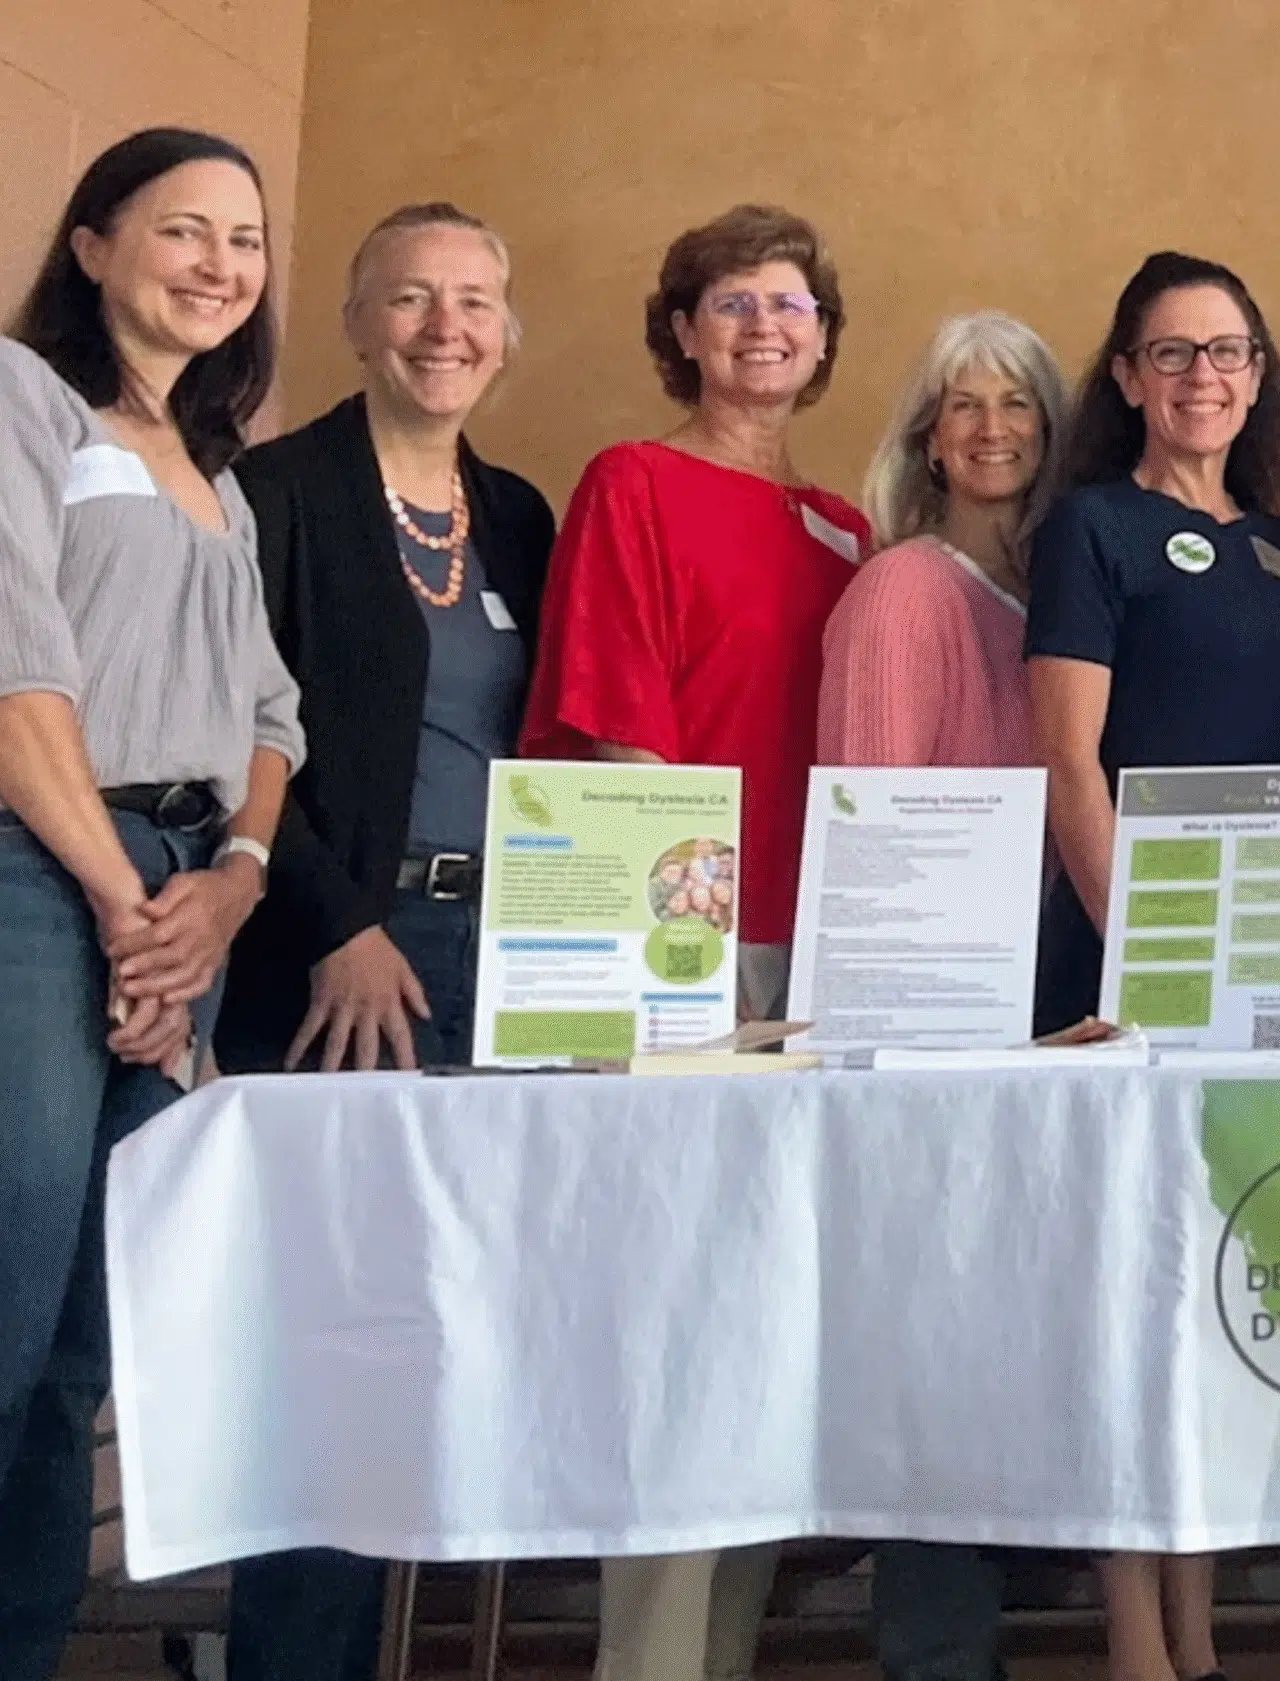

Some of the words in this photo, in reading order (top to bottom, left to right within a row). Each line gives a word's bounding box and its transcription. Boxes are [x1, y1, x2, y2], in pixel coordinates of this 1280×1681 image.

[581, 789, 644, 805] Decoding
[649, 792, 704, 805] Dyslexia
[708, 793, 728, 805] CA
